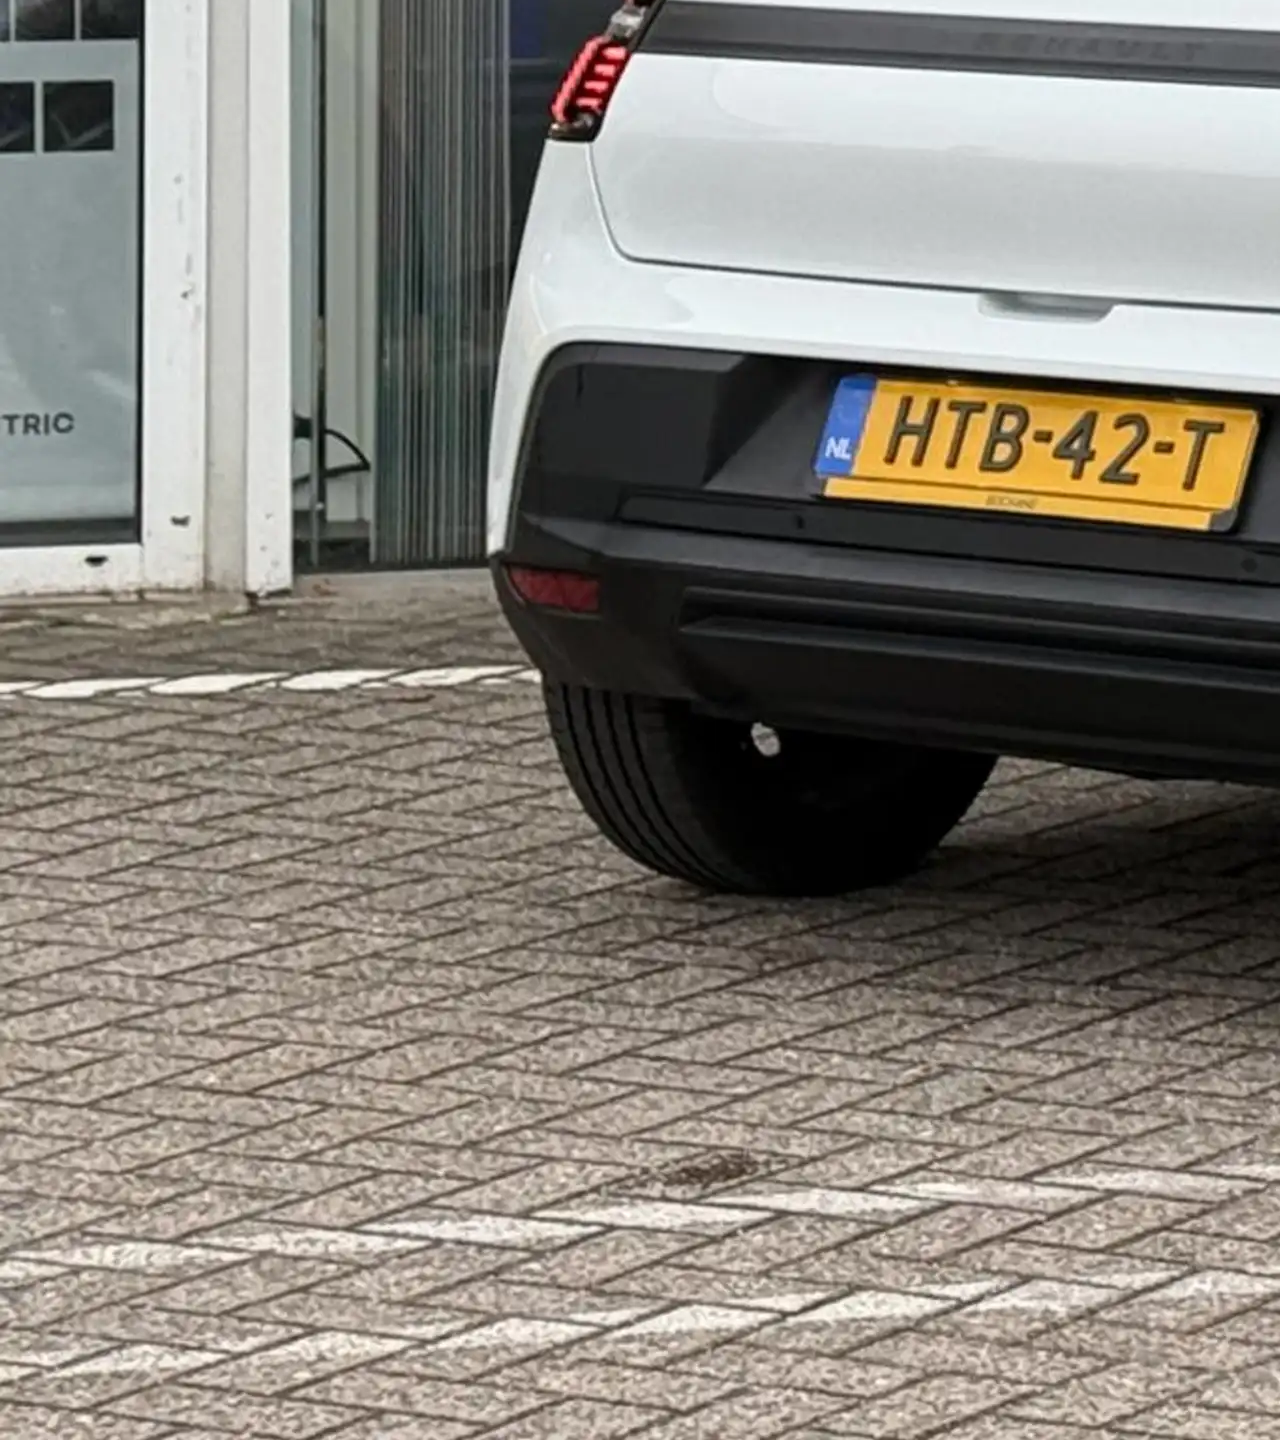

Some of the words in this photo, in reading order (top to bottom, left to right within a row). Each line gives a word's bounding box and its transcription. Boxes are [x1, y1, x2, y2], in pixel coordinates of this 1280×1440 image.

[0, 412, 76, 436] TRIC
[825, 438, 854, 460] NL
[883, 395, 1227, 492] HTB-42-T
